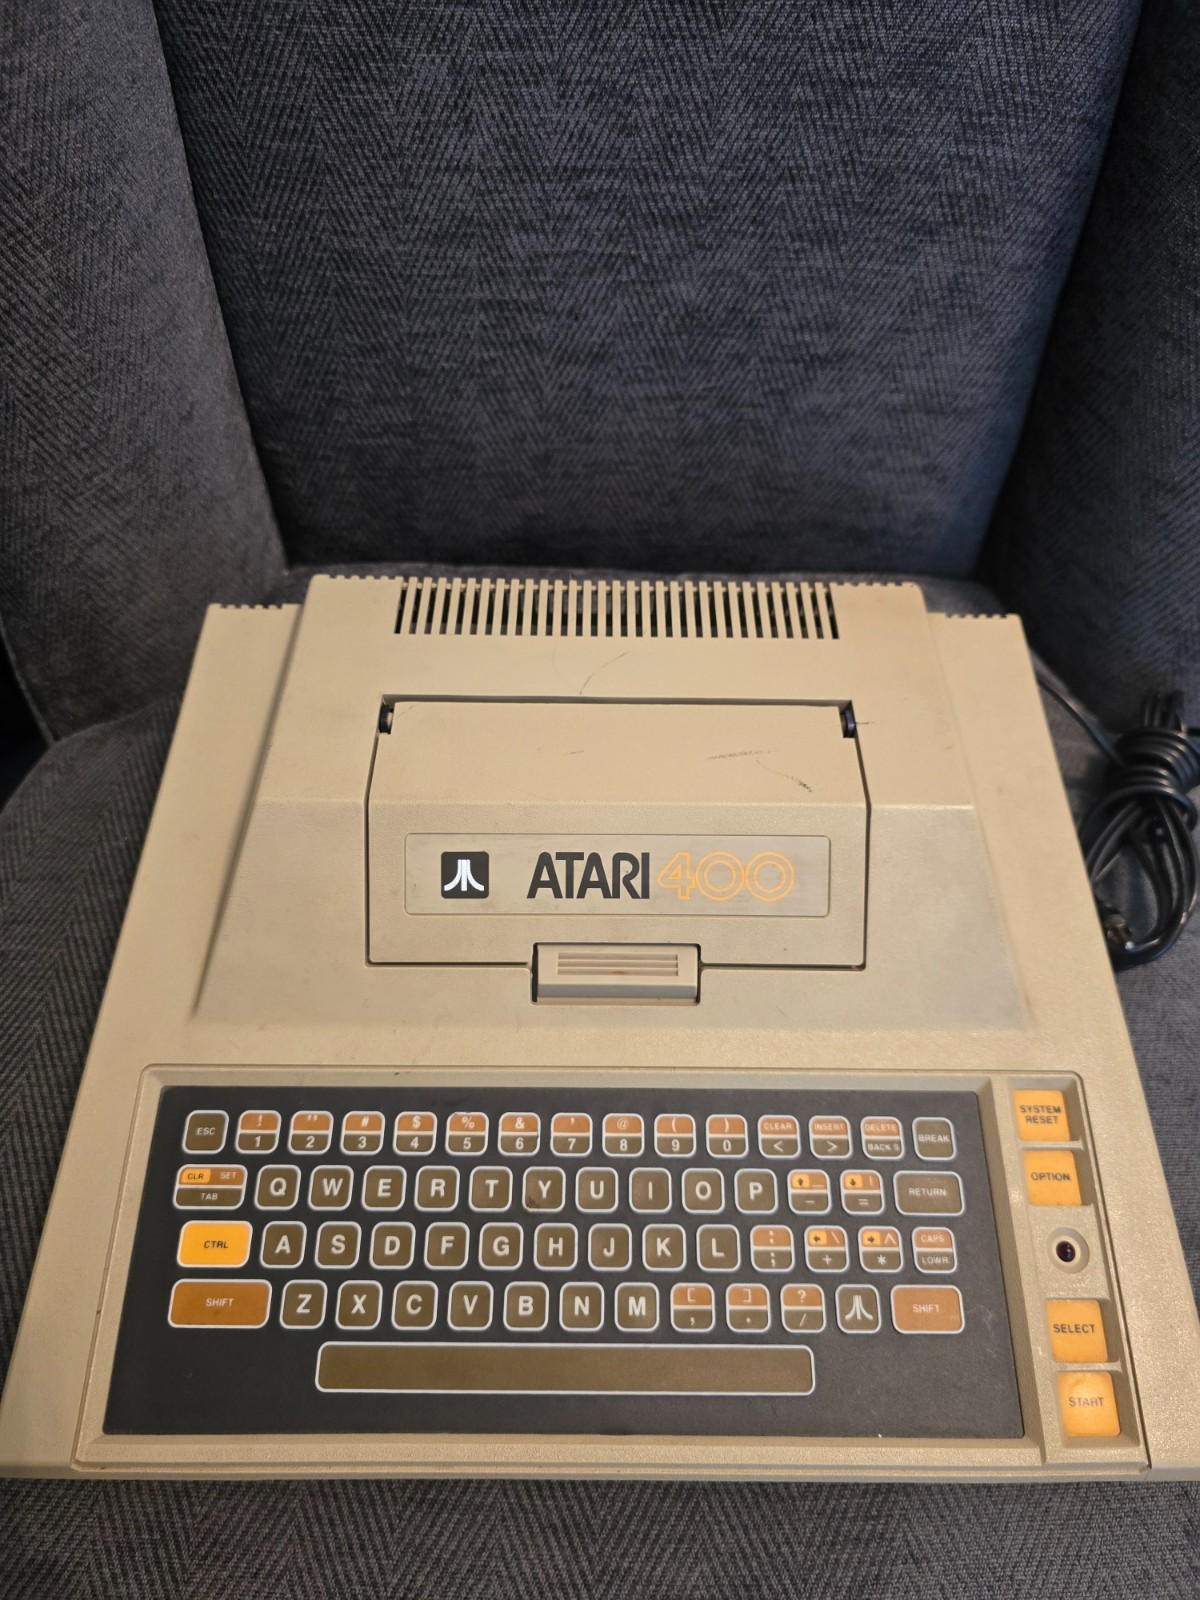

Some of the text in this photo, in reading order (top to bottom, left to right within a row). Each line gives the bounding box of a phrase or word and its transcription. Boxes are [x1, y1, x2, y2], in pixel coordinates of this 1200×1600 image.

[527, 851, 795, 902] ATARI 400
[1019, 1105, 1061, 1114] SYSTEM
[257, 1116, 263, 1127] !
[360, 1116, 370, 1127] #
[412, 1116, 421, 1129] $
[461, 1117, 475, 1128] %
[515, 1117, 525, 1129] &
[616, 1118, 630, 1130] @
[671, 1118, 677, 1132] (
[724, 1118, 729, 1132] )
[1025, 1115, 1058, 1124] RESET
[196, 1126, 216, 1136] ESC
[763, 1122, 792, 1131] CLEAR
[814, 1122, 844, 1131] INSERT
[865, 1123, 897, 1132] DELETE
[254, 1137, 261, 1148] 1
[305, 1137, 315, 1148] 2
[358, 1137, 367, 1148] 3
[410, 1137, 419, 1149] 4
[463, 1138, 472, 1149] 5
[515, 1138, 524, 1150] 6
[918, 1133, 949, 1143] BREAK
[568, 1139, 576, 1150] 7
[619, 1139, 628, 1151] 8
[671, 1140, 680, 1152] 9
[723, 1140, 732, 1152] 0
[773, 1141, 784, 1152] <
[827, 1141, 838, 1152] >
[867, 1143, 899, 1152] BACK S
[187, 1171, 236, 1180] CLR SET
[1031, 1172, 1071, 1181] OPTION
[270, 1178, 287, 1197] Q
[323, 1178, 344, 1195] W
[377, 1179, 392, 1196] E
[431, 1179, 445, 1197] R
[485, 1180, 499, 1198] T
[538, 1180, 552, 1198] Y
[590, 1181, 604, 1199] U
[647, 1181, 653, 1199] I
[695, 1181, 712, 1200] O
[749, 1182, 763, 1200] P
[908, 1187, 947, 1196] RETURN
[200, 1192, 218, 1201] TAB
[858, 1198, 869, 1207] =
[769, 1229, 774, 1244] :
[920, 1234, 944, 1243] CAPS
[203, 1240, 229, 1249] CTRL
[275, 1235, 291, 1254] A
[330, 1235, 346, 1254] S
[384, 1236, 401, 1255] D
[441, 1236, 455, 1255] F
[493, 1236, 510, 1256] G
[548, 1237, 564, 1256] H
[603, 1238, 615, 1257] J
[656, 1238, 673, 1256] K
[711, 1239, 724, 1257] L
[770, 1251, 776, 1266] ;
[822, 1255, 832, 1265] +
[921, 1255, 949, 1265] LOWR
[687, 1288, 696, 1302] [
[743, 1289, 751, 1302] ]
[797, 1290, 806, 1303] ?
[205, 1297, 235, 1307] SHIFT
[296, 1294, 312, 1313] Z
[350, 1295, 367, 1313] X
[406, 1295, 423, 1314] C
[463, 1296, 478, 1314] V
[518, 1296, 534, 1315] B
[575, 1296, 590, 1315] N
[628, 1296, 646, 1316] M
[912, 1303, 940, 1313] SHIFT
[799, 1314, 807, 1326] /
[1053, 1324, 1095, 1334] SELECT
[1068, 1397, 1104, 1407] START
